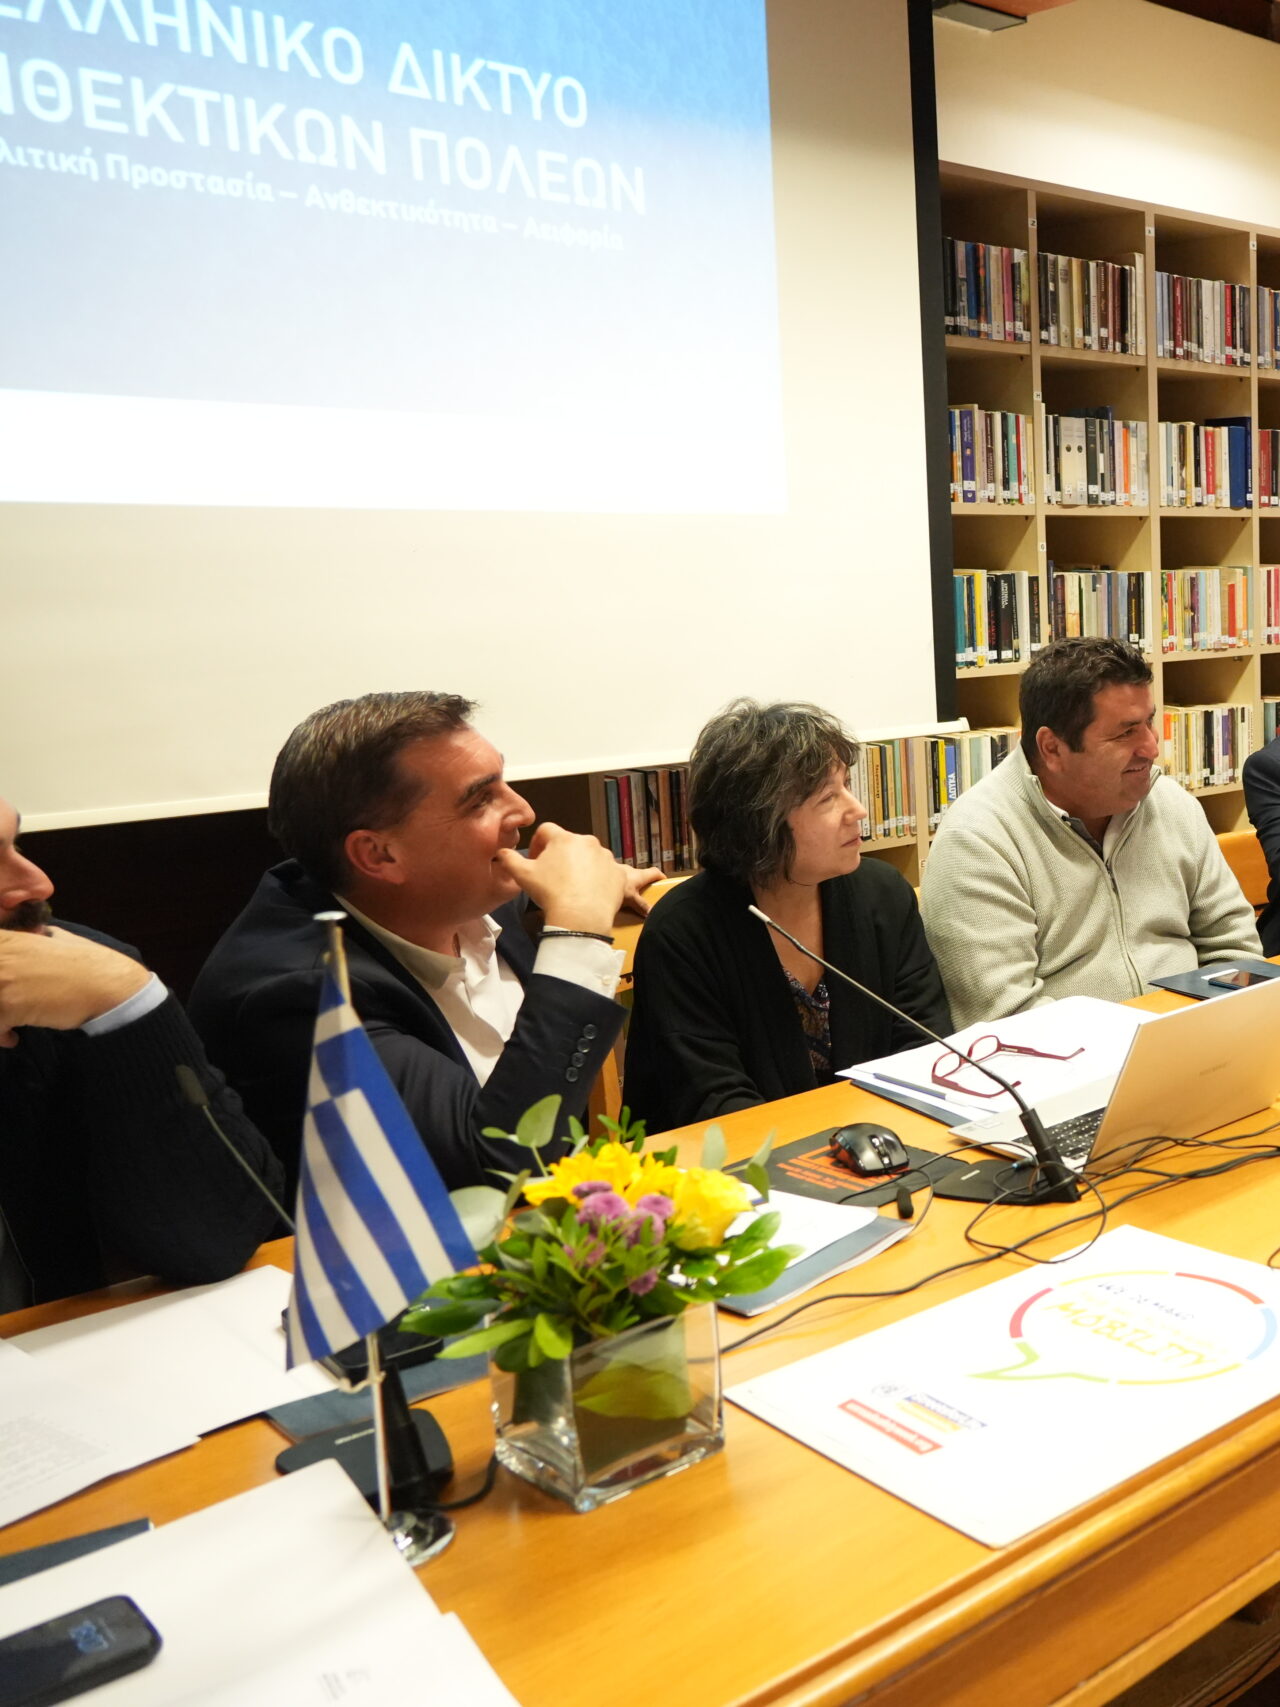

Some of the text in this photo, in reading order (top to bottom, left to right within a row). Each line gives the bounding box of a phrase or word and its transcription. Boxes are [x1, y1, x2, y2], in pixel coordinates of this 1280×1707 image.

[0, 0, 589, 128] ΛΗΝΙΚΟ ΔΙΚΤΥΟ
[0, 52, 647, 215] ΘΕΚΤΙΚΩΝ ΠΟΛΕΩΝ
[106, 153, 275, 203] Προστασία
[304, 184, 499, 233] Ανθεκτικότητα
